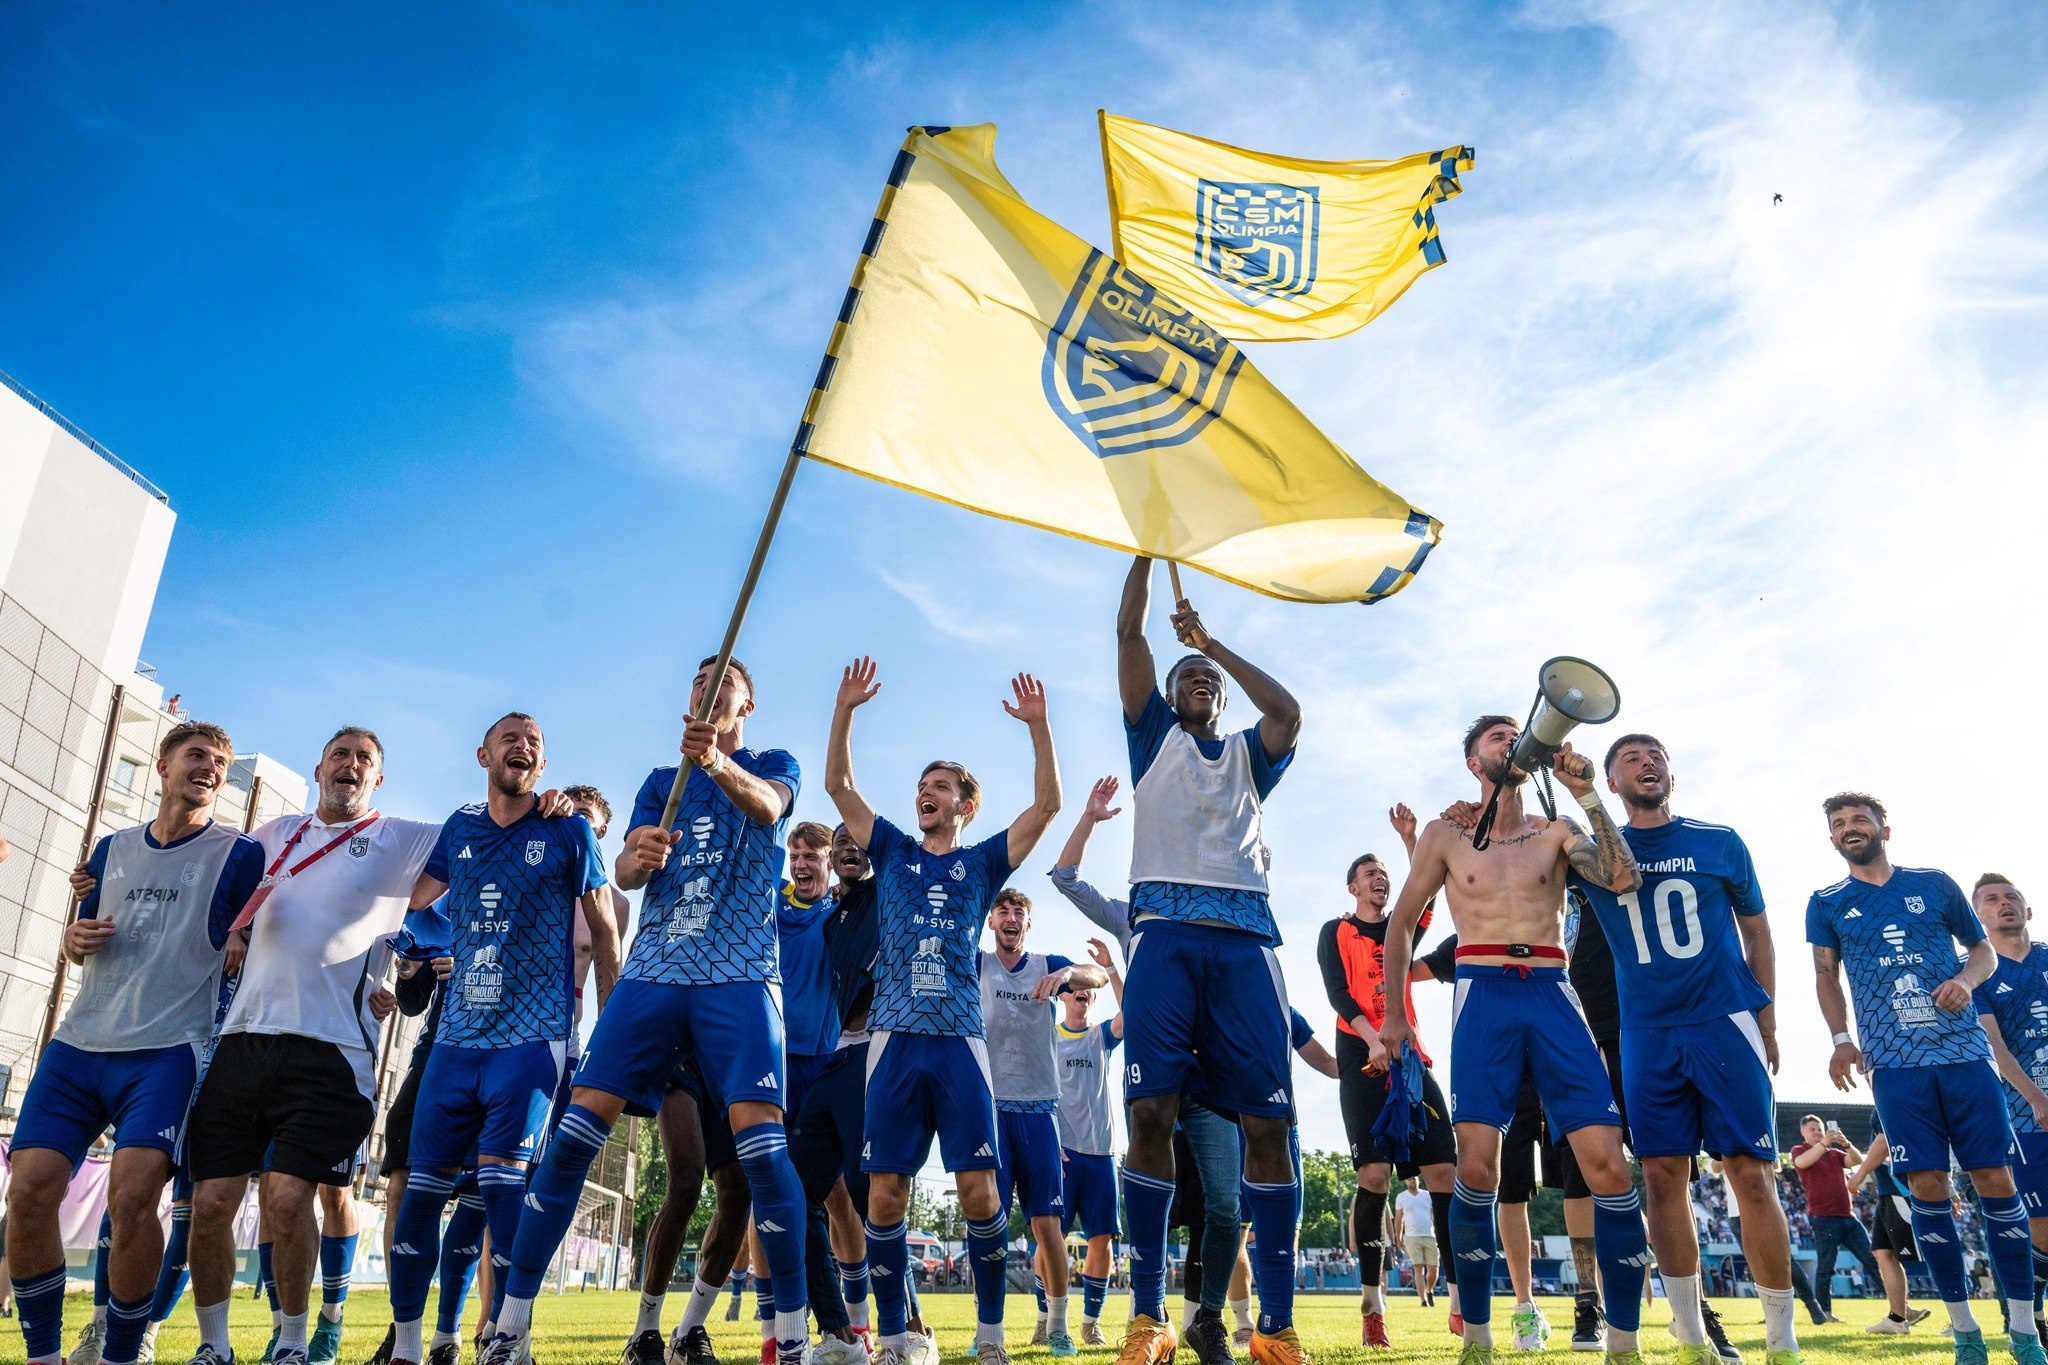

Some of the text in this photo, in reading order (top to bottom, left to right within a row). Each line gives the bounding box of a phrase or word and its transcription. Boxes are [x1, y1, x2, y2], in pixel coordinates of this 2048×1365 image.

[1216, 205, 1300, 224] CSM
[1215, 223, 1298, 237] OLIMPIA
[1102, 290, 1217, 352] OLIMPIA
[681, 851, 723, 866] M-SYS
[471, 920, 509, 932] M-SYS
[913, 914, 955, 930] M-SYS
[1617, 878, 1704, 964] 10
[1879, 953, 1923, 966] M-SYS
[911, 961, 946, 976] BEST BUILD
[465, 973, 503, 985] BEST BUILD
[464, 985, 502, 998] TECHNOLOGY
[996, 990, 1029, 1001] KIPSTA
[1892, 996, 1933, 1009] BEST BUILD
[1896, 1006, 1936, 1019] TECHNOLOGY
[2025, 1028, 2048, 1038] M-S
[1066, 1059, 1093, 1068] KIPSTA
[1125, 1063, 1142, 1085] 19
[861, 1141, 872, 1160] 4
[1891, 1144, 1909, 1162] 22
[2024, 1191, 2042, 1208] 11
